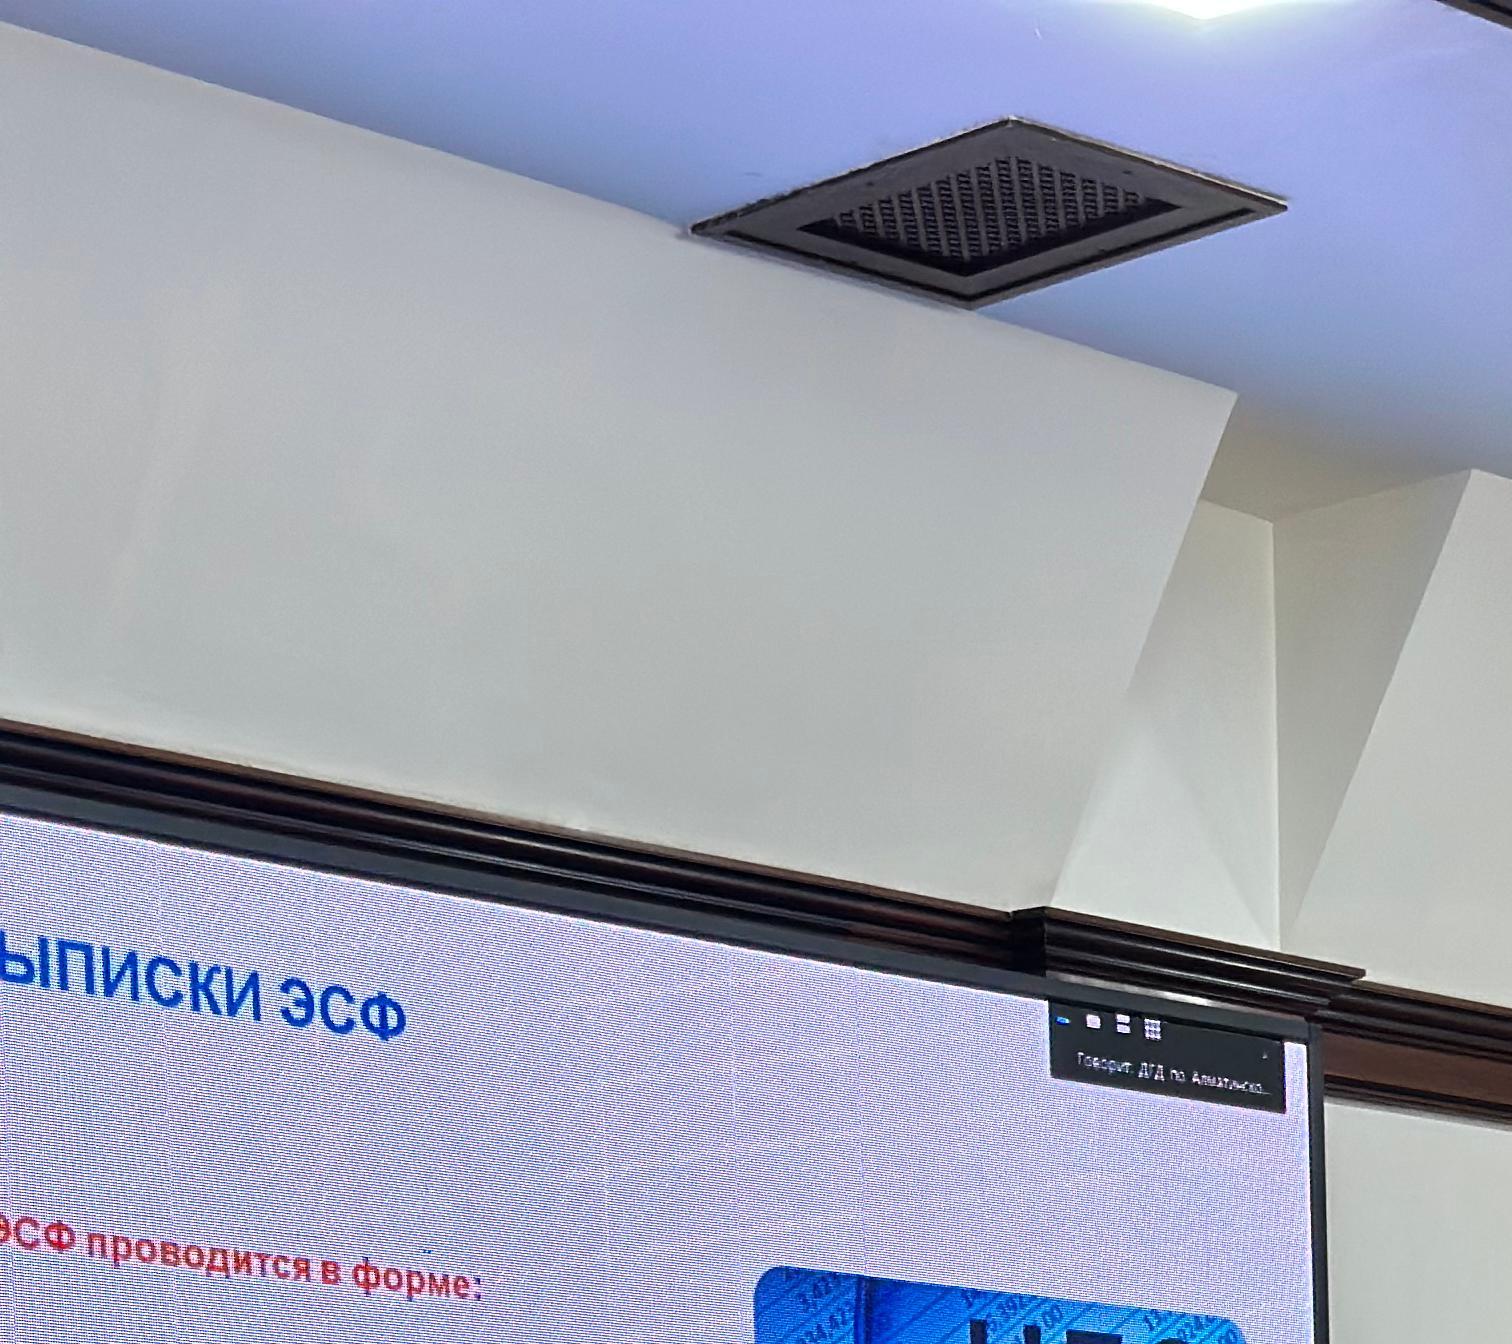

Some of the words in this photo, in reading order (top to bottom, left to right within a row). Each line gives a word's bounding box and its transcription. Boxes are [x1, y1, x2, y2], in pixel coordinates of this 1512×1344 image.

[0, 930, 262, 1022] ЫПИСКИ
[278, 977, 407, 1041] ЭСФ
[87, 1230, 312, 1281] проводится
[320, 1259, 341, 1285] в
[352, 1256, 483, 1301] форме:
